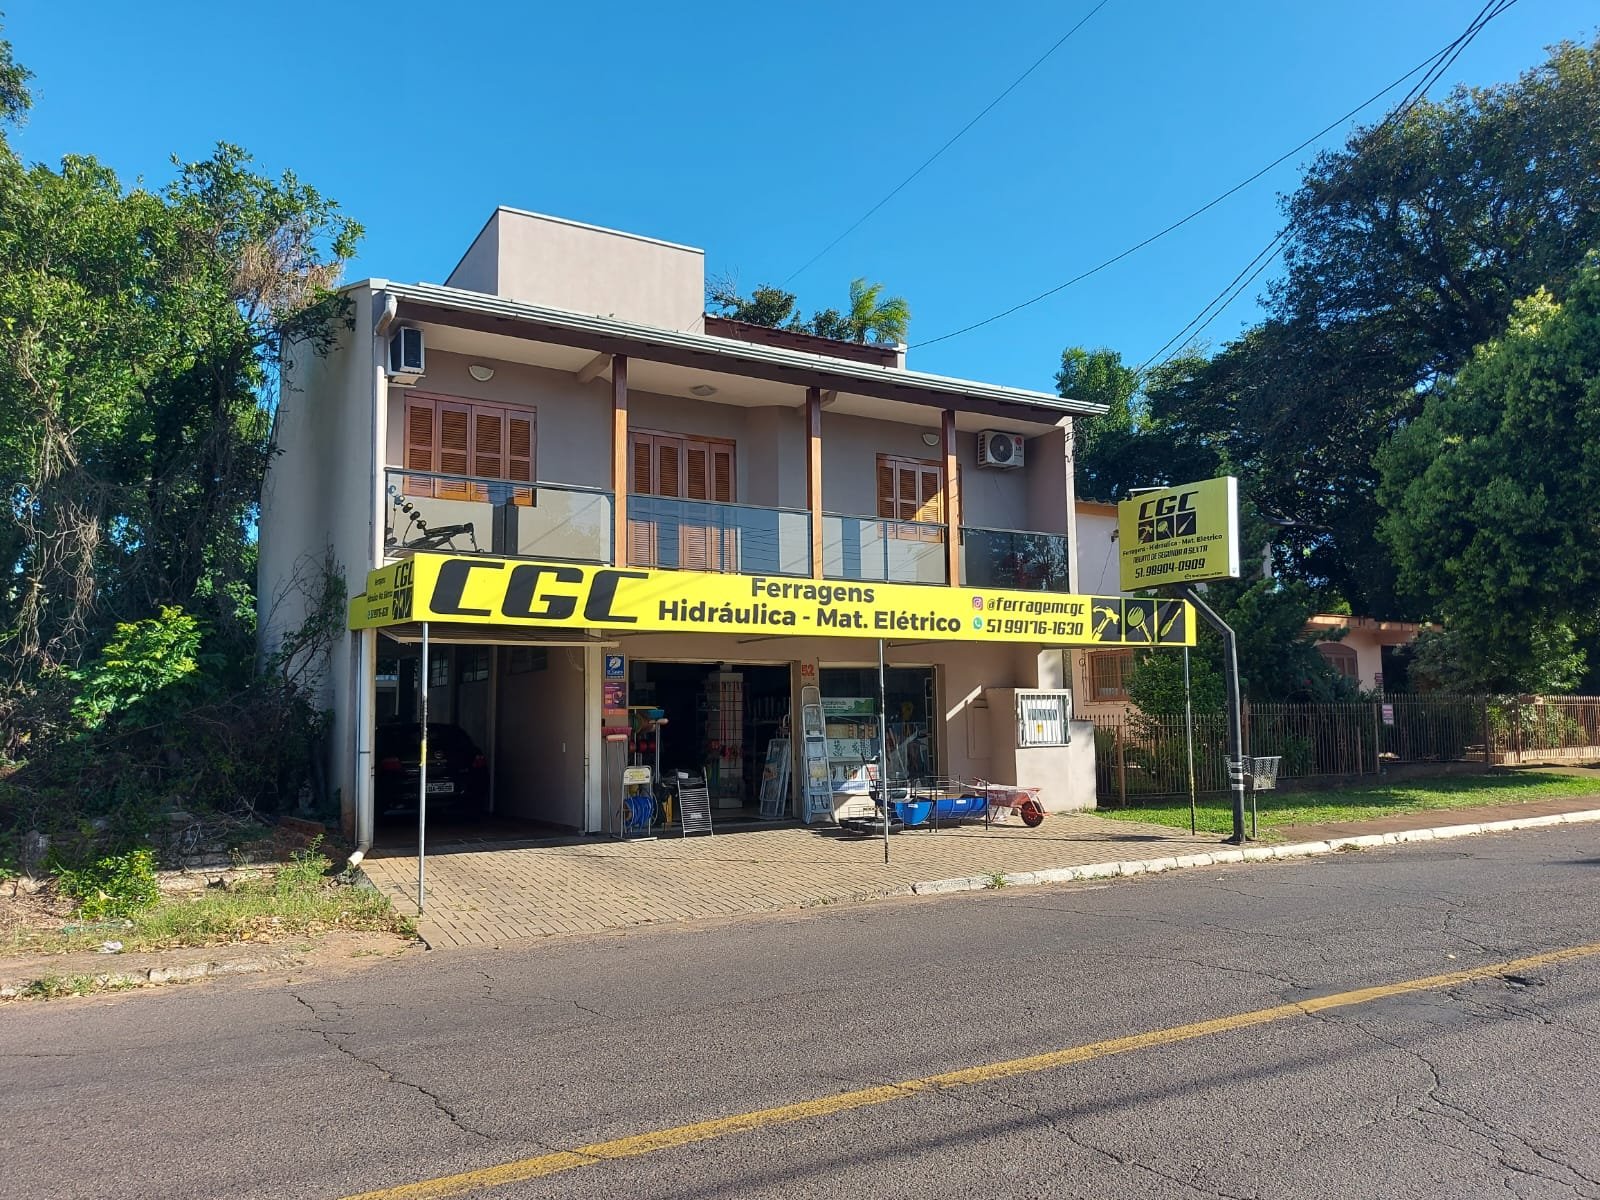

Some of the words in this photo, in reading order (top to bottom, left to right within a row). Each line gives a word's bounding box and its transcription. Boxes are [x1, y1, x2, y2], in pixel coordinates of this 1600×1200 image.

[1138, 491, 1199, 520] CGC
[1188, 545, 1207, 554] SEXTA
[429, 559, 649, 623] CGC
[751, 577, 875, 606] Ferragens
[658, 598, 796, 626] Hidráulica
[816, 608, 868, 629] Mat.
[874, 611, 961, 632] Elétrico
[987, 597, 1085, 616] @ferragemcgc
[801, 664, 815, 677] 52
